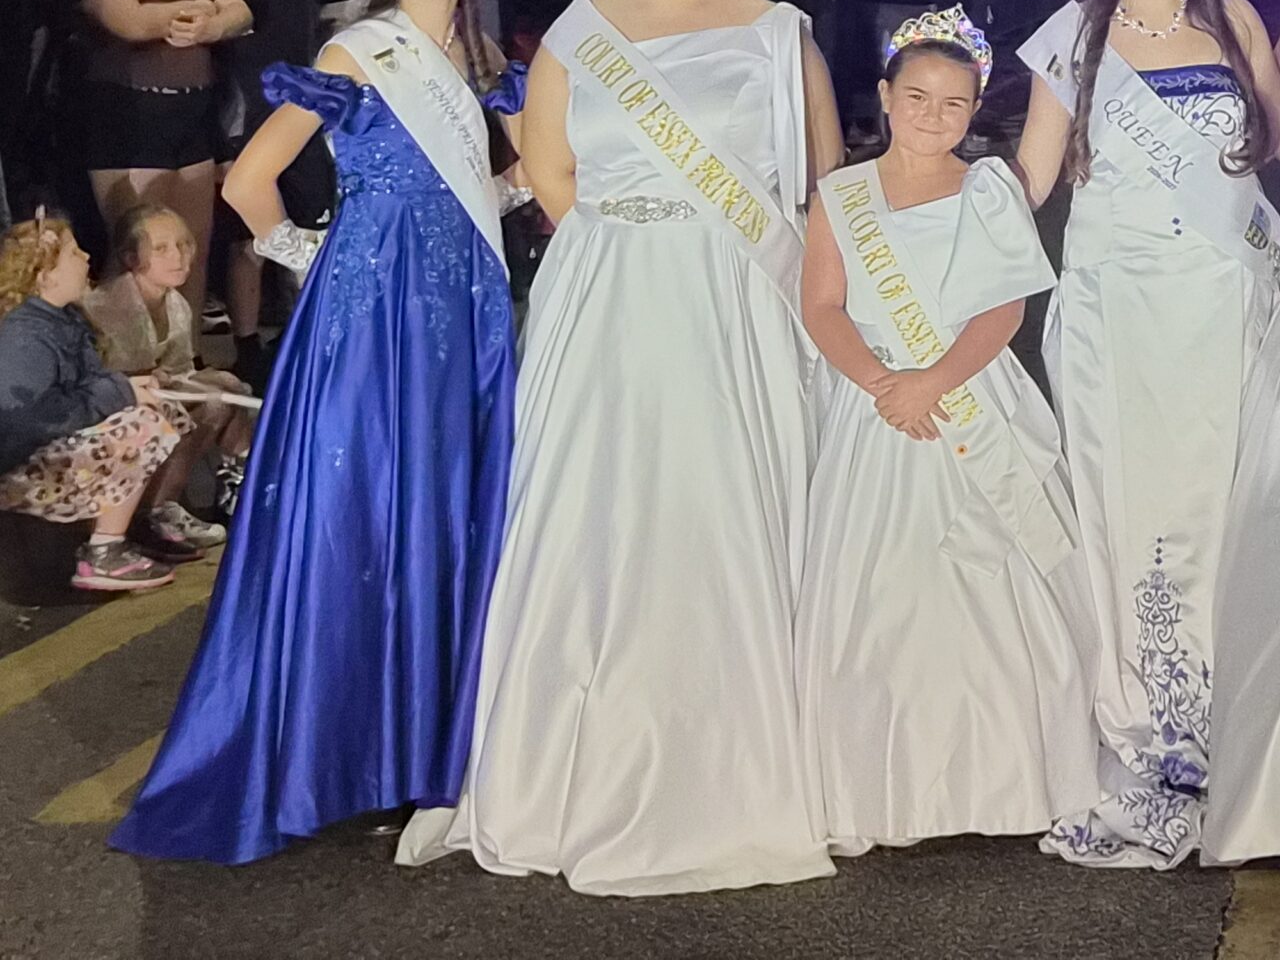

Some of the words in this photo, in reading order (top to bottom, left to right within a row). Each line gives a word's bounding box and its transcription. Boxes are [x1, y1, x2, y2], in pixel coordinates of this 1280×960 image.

[574, 33, 637, 90] COURT
[422, 77, 461, 128] SENIOR
[617, 79, 659, 113] OF
[636, 99, 706, 170] ESSEX
[1103, 98, 1194, 184] QUEEN
[686, 152, 771, 245] PRINCESS
[832, 179, 872, 216] JNR
[848, 209, 898, 277] COURT
[875, 272, 913, 303] OF
[889, 300, 945, 367] ESSEX
